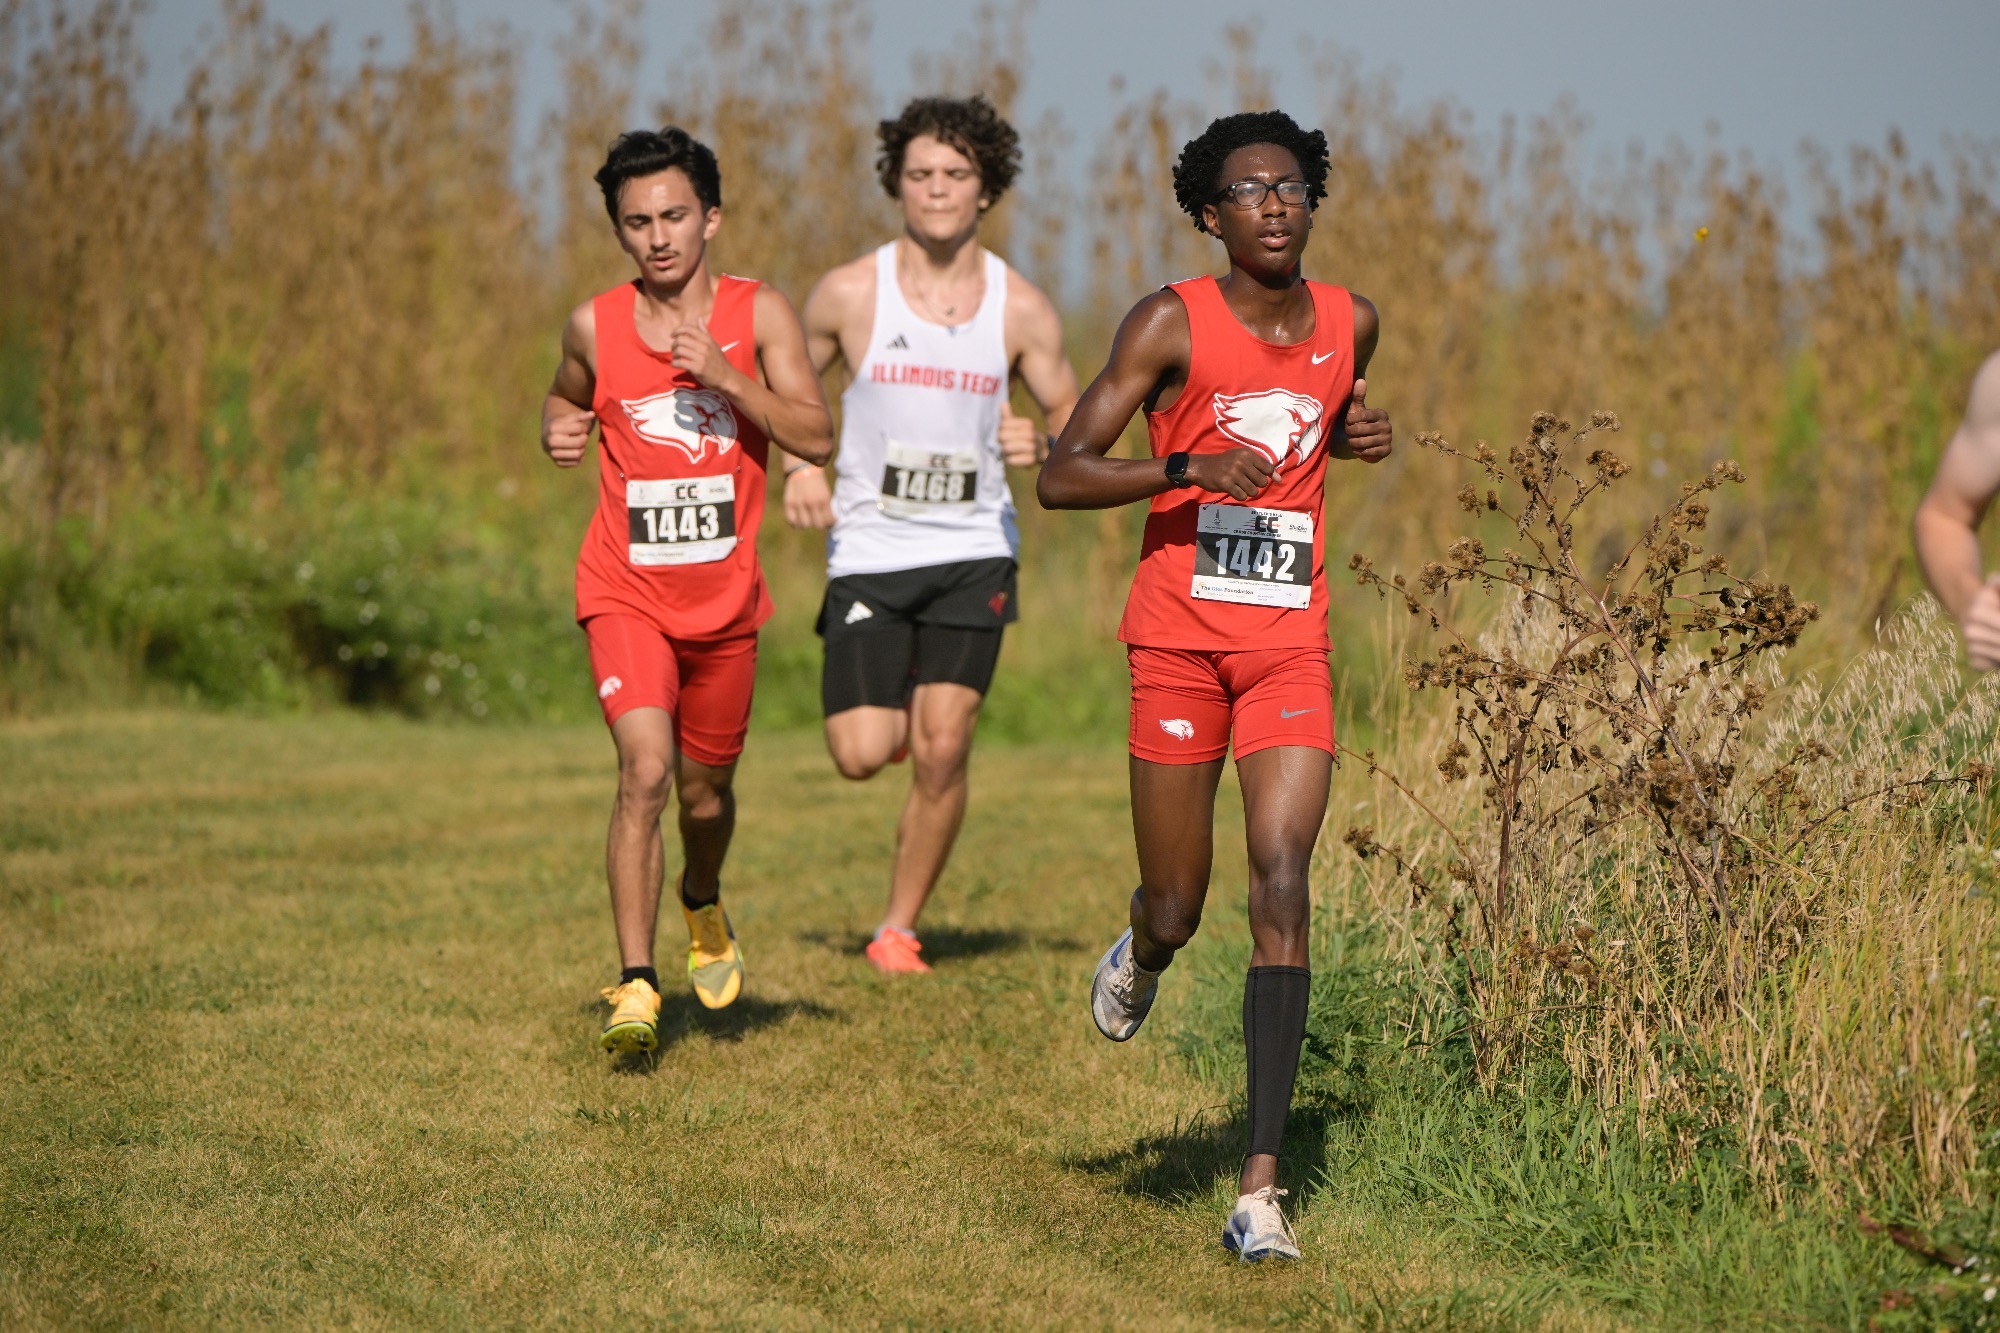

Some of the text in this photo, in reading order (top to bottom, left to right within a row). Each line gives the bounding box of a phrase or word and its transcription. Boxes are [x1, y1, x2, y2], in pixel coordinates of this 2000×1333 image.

[873, 363, 1001, 396] ILLINOIS TECH
[930, 454, 952, 468] CC
[675, 485, 698, 500] CC
[895, 470, 966, 502] 1468
[642, 504, 720, 543] 1443
[1254, 515, 1279, 533] CC
[1215, 537, 1296, 581] 1442
